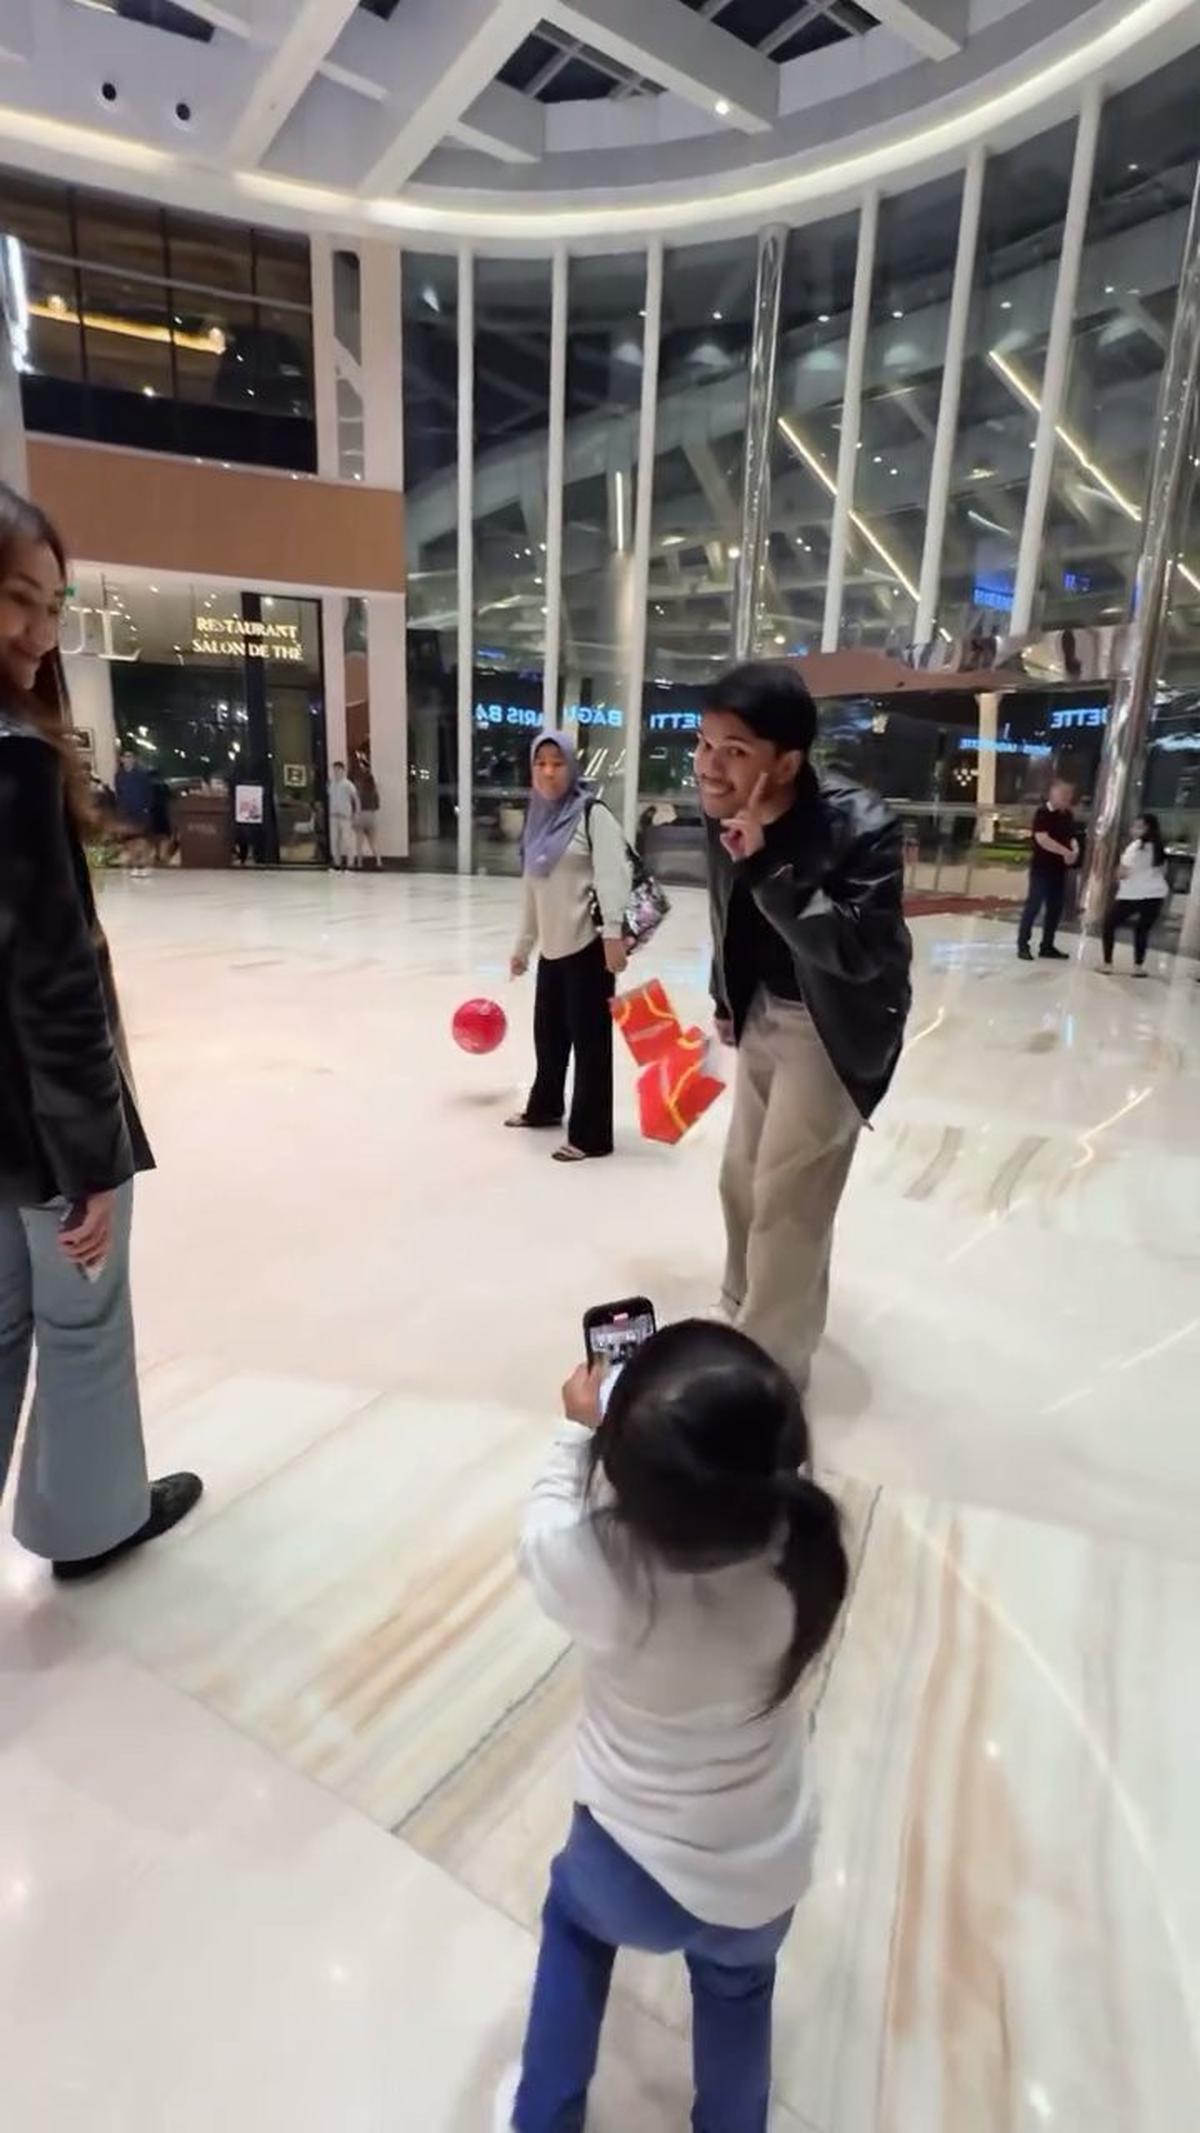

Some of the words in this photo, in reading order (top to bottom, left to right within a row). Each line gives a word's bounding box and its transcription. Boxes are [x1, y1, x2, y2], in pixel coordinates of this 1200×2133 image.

[196, 617, 298, 639] RESTAURANT
[192, 639, 246, 656] SALON
[247, 643, 270, 658] DE
